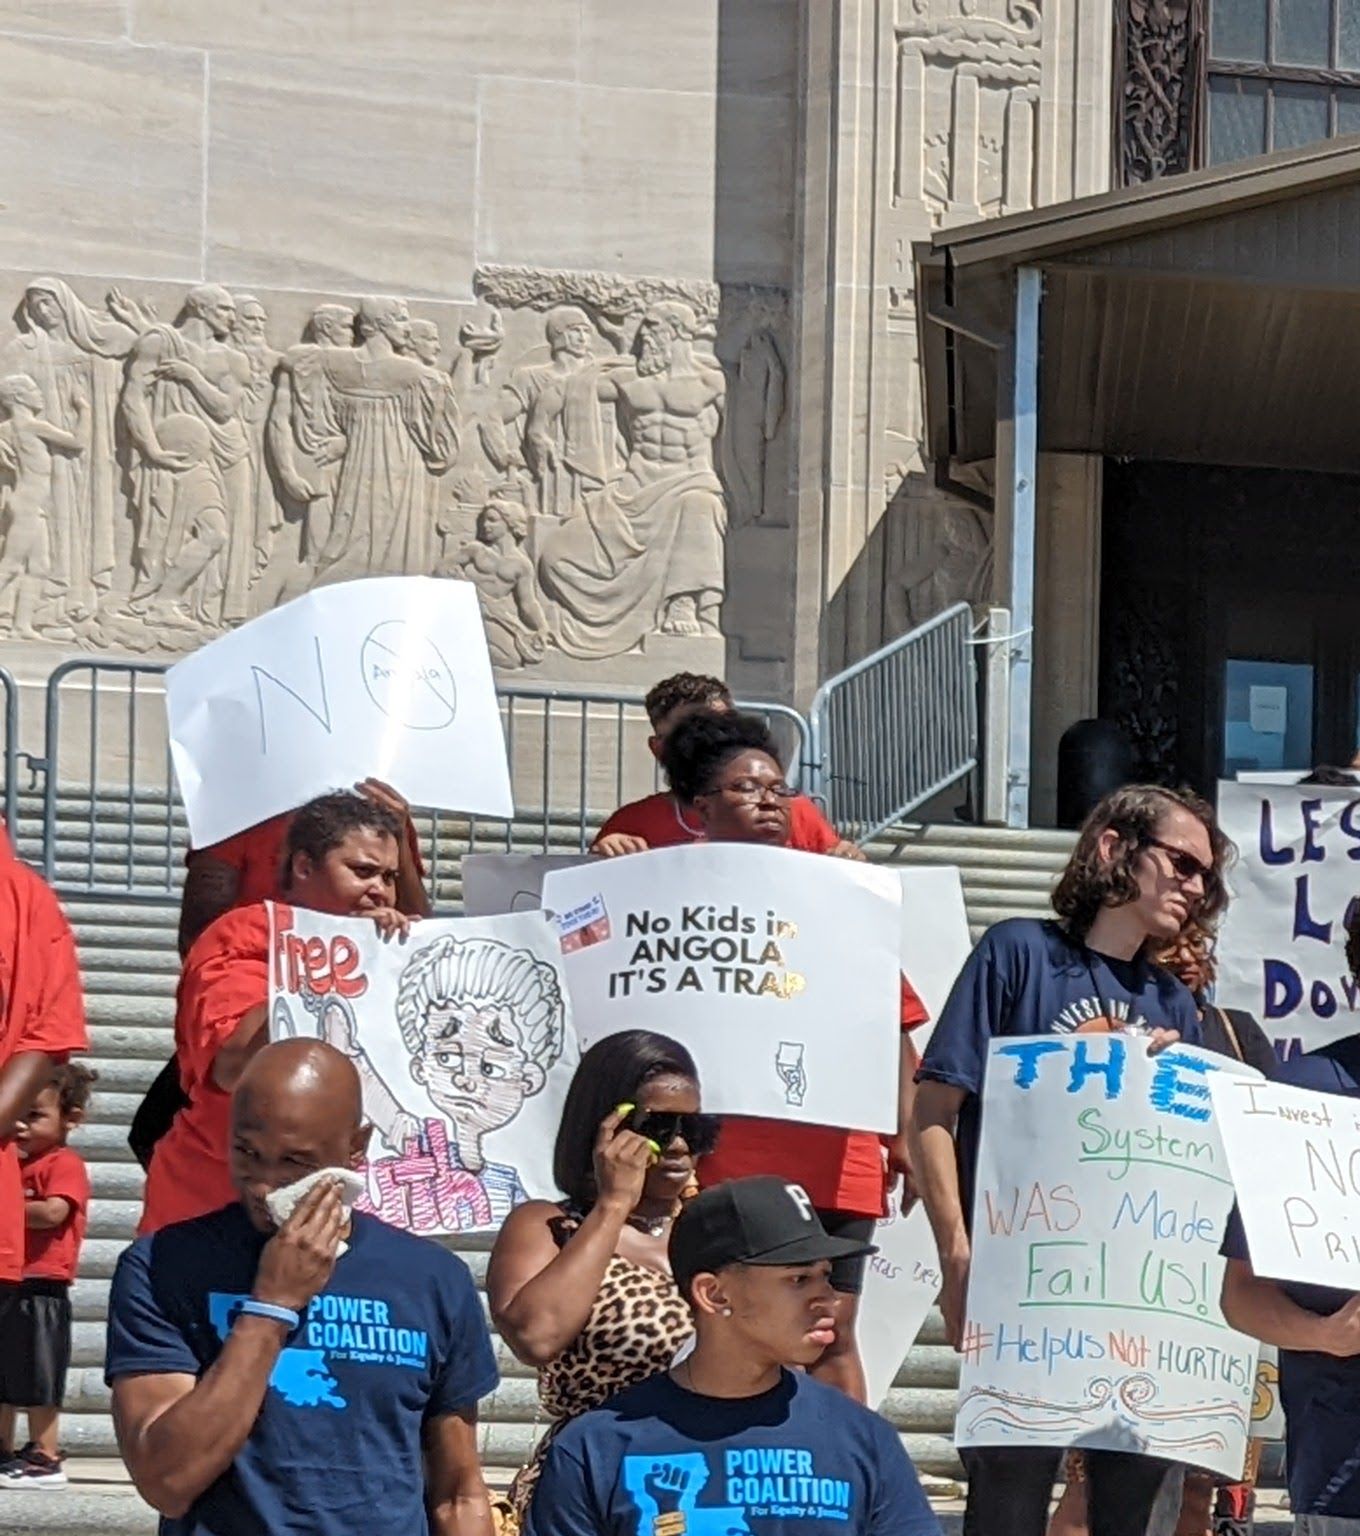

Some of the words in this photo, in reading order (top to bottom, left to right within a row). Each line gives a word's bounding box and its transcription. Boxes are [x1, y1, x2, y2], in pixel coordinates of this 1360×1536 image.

[625, 910, 671, 938] No
[681, 905, 756, 935] Kids
[629, 936, 784, 967] ANGOLA
[608, 969, 668, 999] IT'S
[676, 966, 704, 993] A
[994, 1038, 1222, 1123] THE
[307, 1294, 390, 1326] POWER
[307, 1321, 428, 1357] COALITION
[725, 1448, 813, 1476] POWER
[726, 1476, 850, 1508] COALITION
[770, 1505, 807, 1517] Equity
[807, 1506, 816, 1516] &
